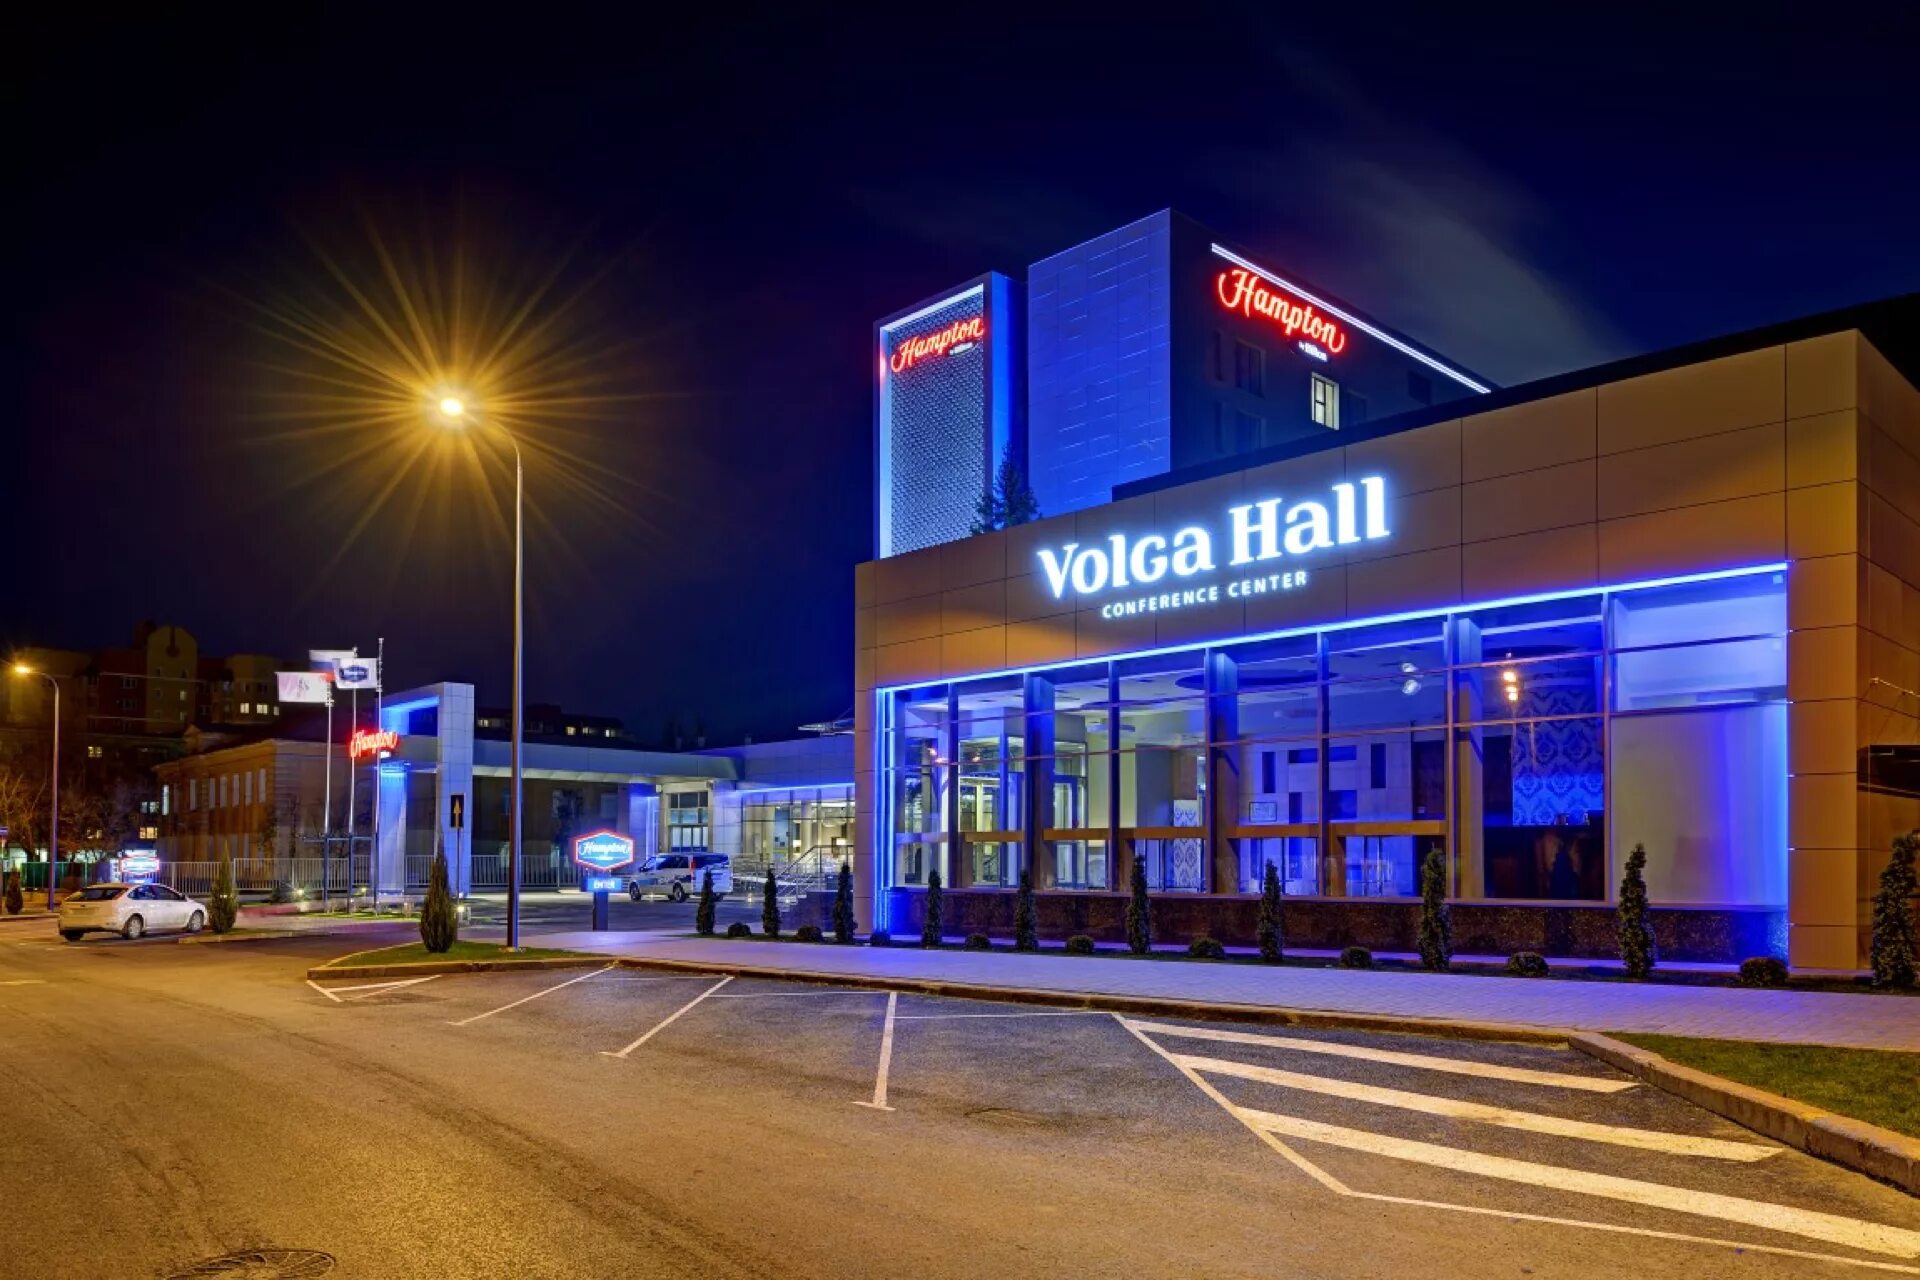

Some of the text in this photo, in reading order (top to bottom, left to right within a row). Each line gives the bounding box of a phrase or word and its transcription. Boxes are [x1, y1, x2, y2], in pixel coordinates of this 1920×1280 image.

[1218, 269, 1345, 353] Hampton
[891, 317, 984, 373] Hampton
[1229, 476, 1390, 566] Hall
[1102, 571, 1308, 620] CONFERENCE CENTER
[579, 841, 630, 857] Hampton
